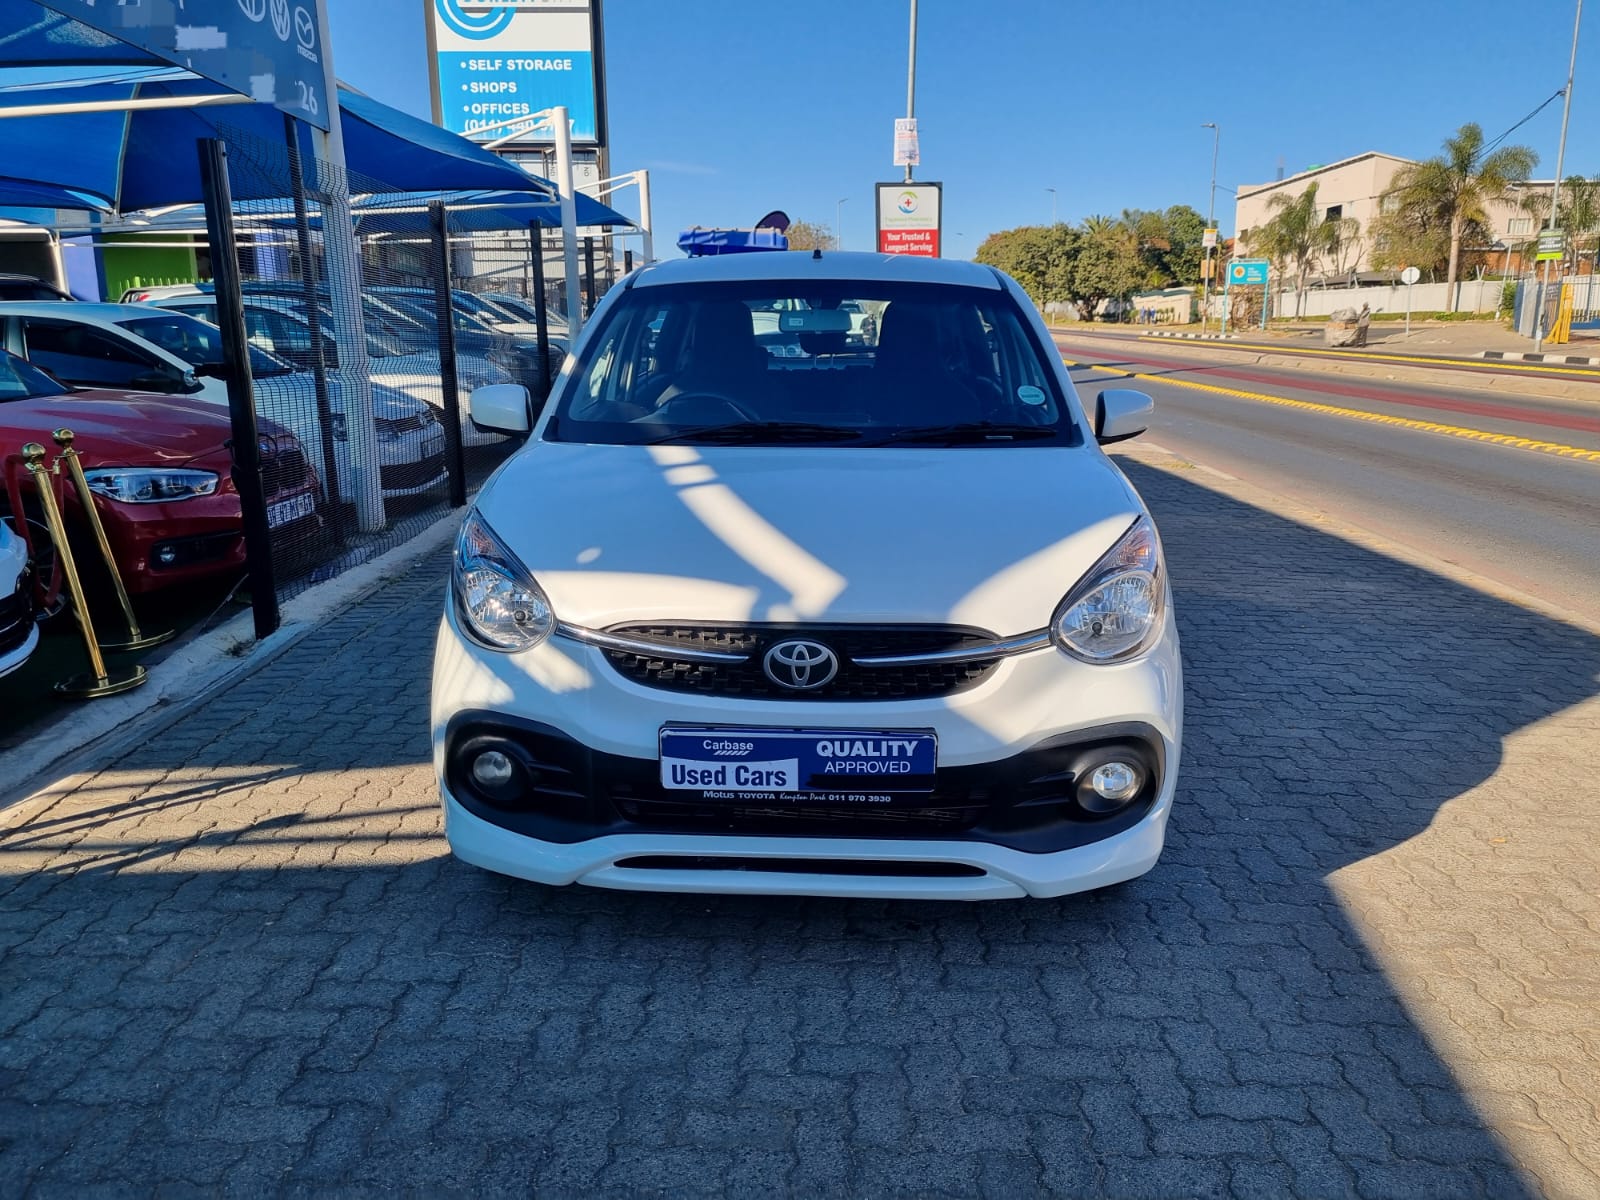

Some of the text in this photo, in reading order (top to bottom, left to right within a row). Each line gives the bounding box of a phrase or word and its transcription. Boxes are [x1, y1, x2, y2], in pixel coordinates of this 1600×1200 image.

[469, 59, 572, 71] SELF STORAGE
[470, 82, 517, 93] SHOPS
[471, 103, 530, 115] OFFICES
[886, 232, 931, 241] Your Trusted &
[884, 242, 933, 252] Longest Serving
[702, 739, 754, 751] Carbase
[816, 740, 919, 758] QUALITY
[824, 760, 911, 774] APPROVED
[671, 764, 787, 787] Used Cars
[703, 790, 735, 799] Motus
[737, 792, 776, 800] TOYOTA
[828, 794, 846, 802] 011
[848, 794, 866, 802] 970
